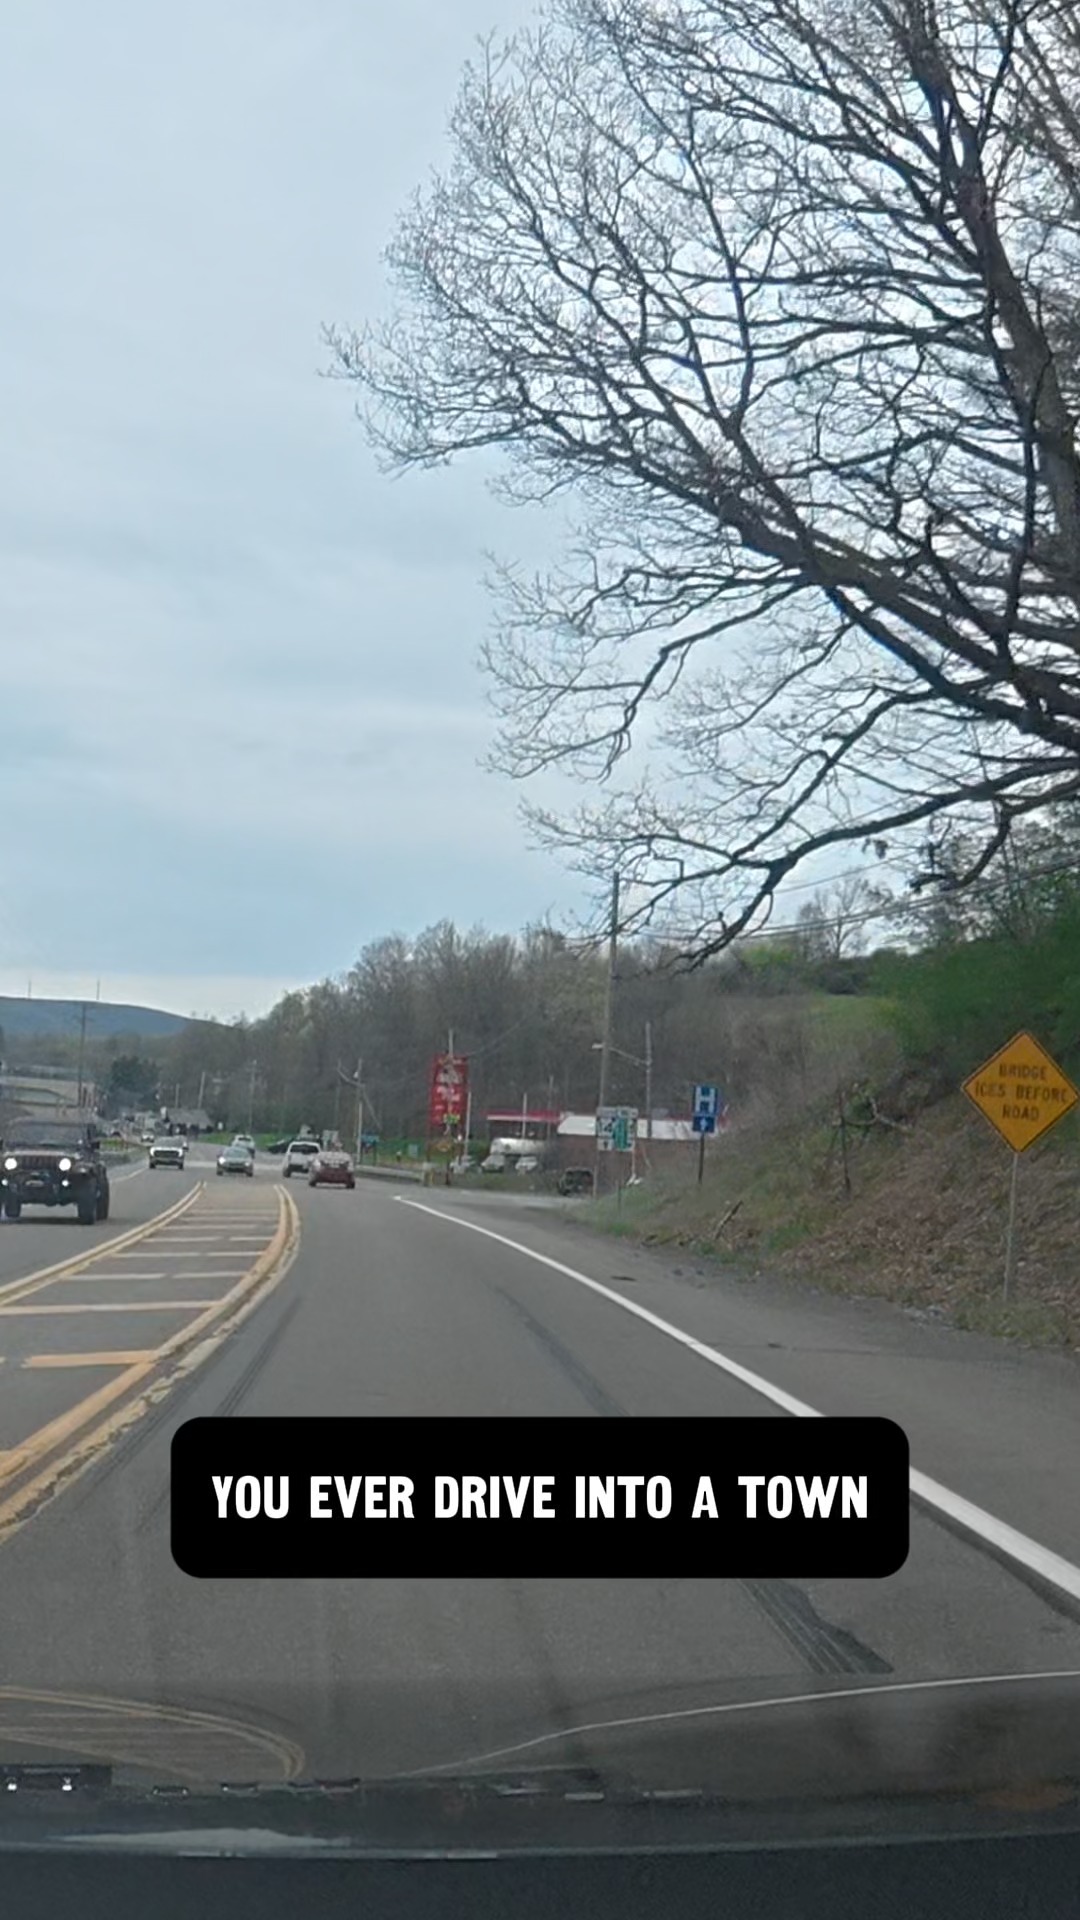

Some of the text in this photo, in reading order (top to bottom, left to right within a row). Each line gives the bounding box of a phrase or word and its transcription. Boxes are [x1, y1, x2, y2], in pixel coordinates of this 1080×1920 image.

[999, 1063, 1047, 1081] BRIDGE
[694, 1085, 716, 1114] H
[975, 1081, 1068, 1104] ICES BEFORE
[1002, 1104, 1040, 1120] ROAD
